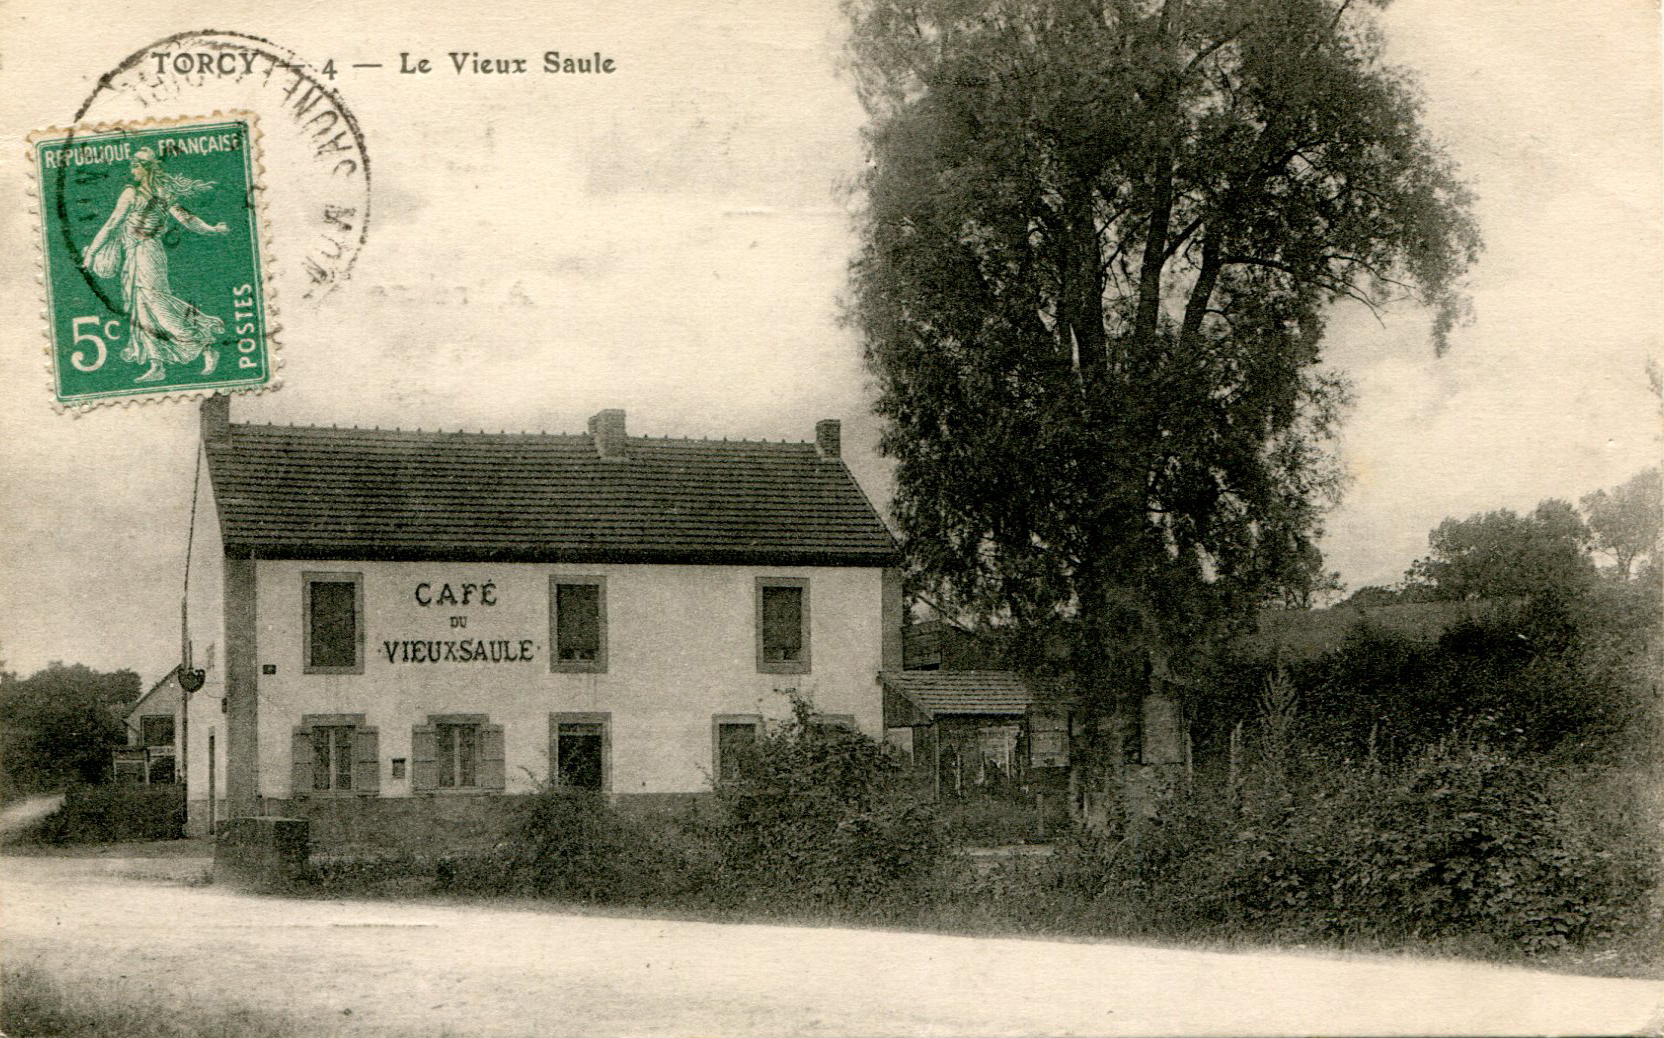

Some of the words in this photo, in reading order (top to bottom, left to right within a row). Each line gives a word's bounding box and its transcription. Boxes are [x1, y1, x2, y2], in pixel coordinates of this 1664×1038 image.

[233, 283, 257, 369] POSTES
[414, 579, 498, 607] CAFÉ
[450, 616, 468, 629] DU
